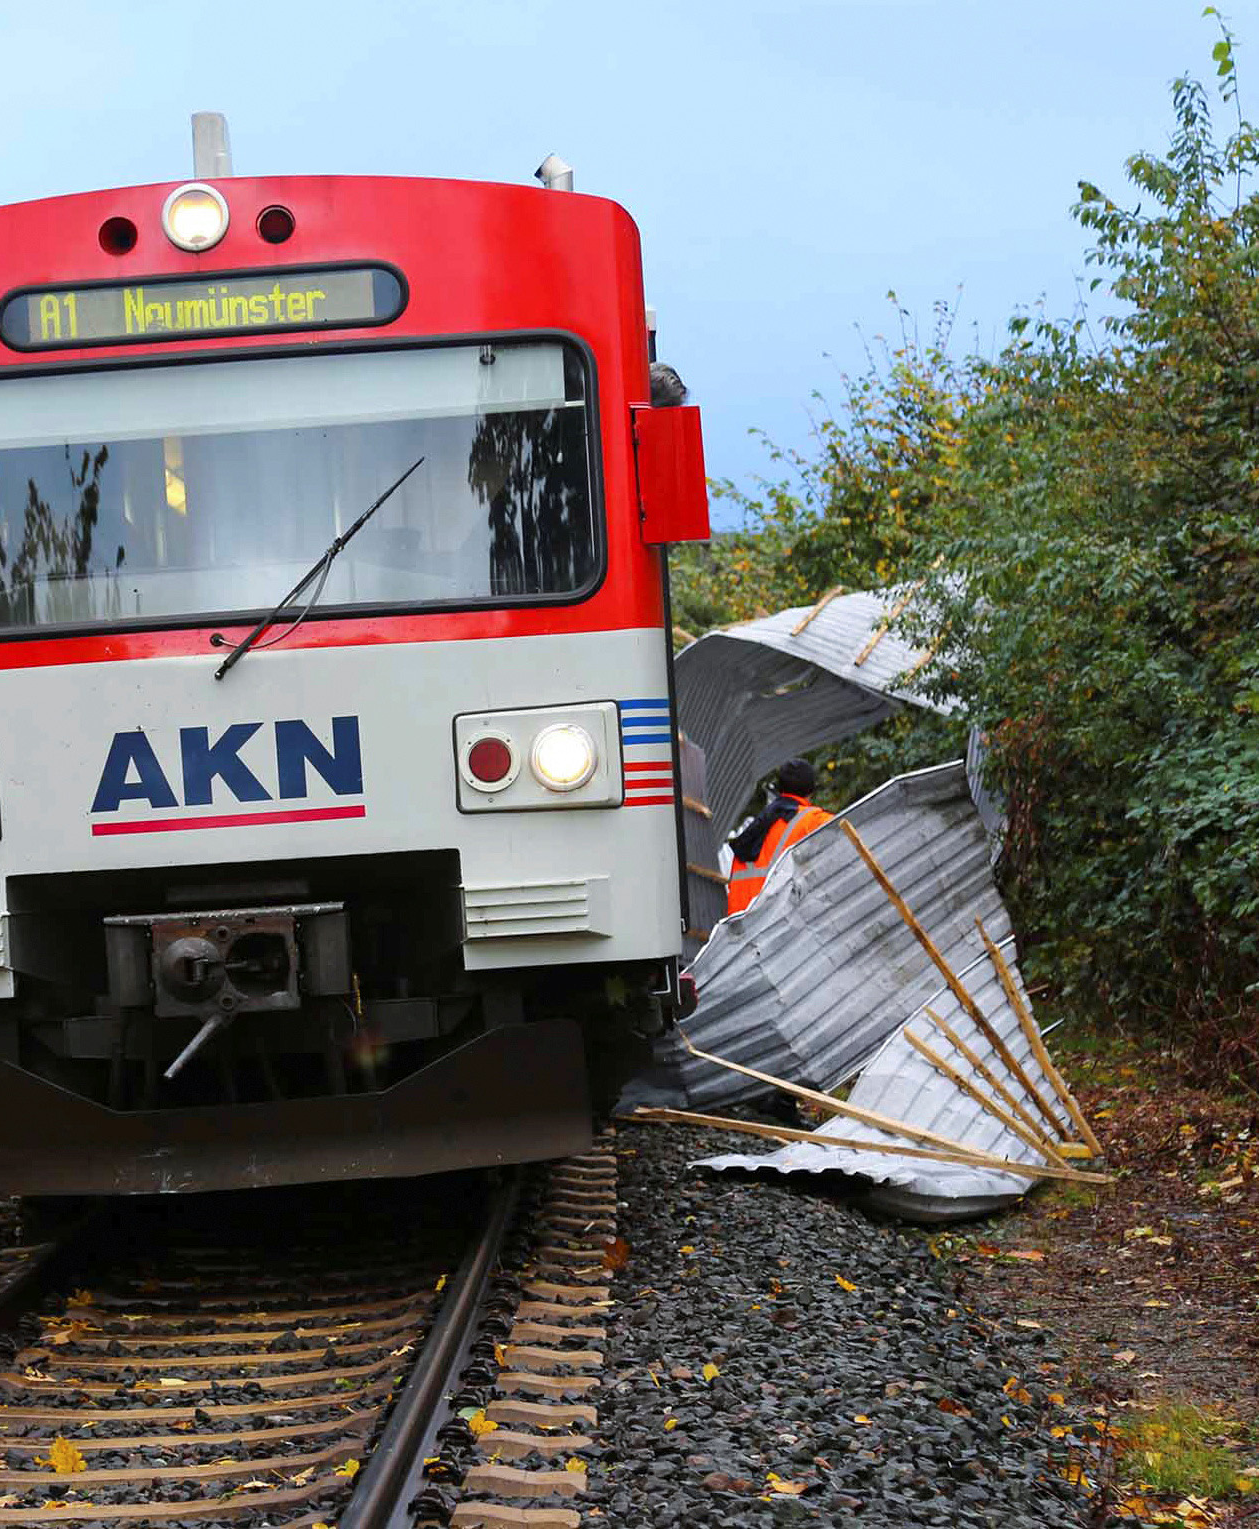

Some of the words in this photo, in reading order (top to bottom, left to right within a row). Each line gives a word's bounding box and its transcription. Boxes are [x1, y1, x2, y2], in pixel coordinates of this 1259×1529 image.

[40, 293, 78, 340] A1
[123, 284, 326, 333] Neumünster
[90, 715, 364, 813] AKN
